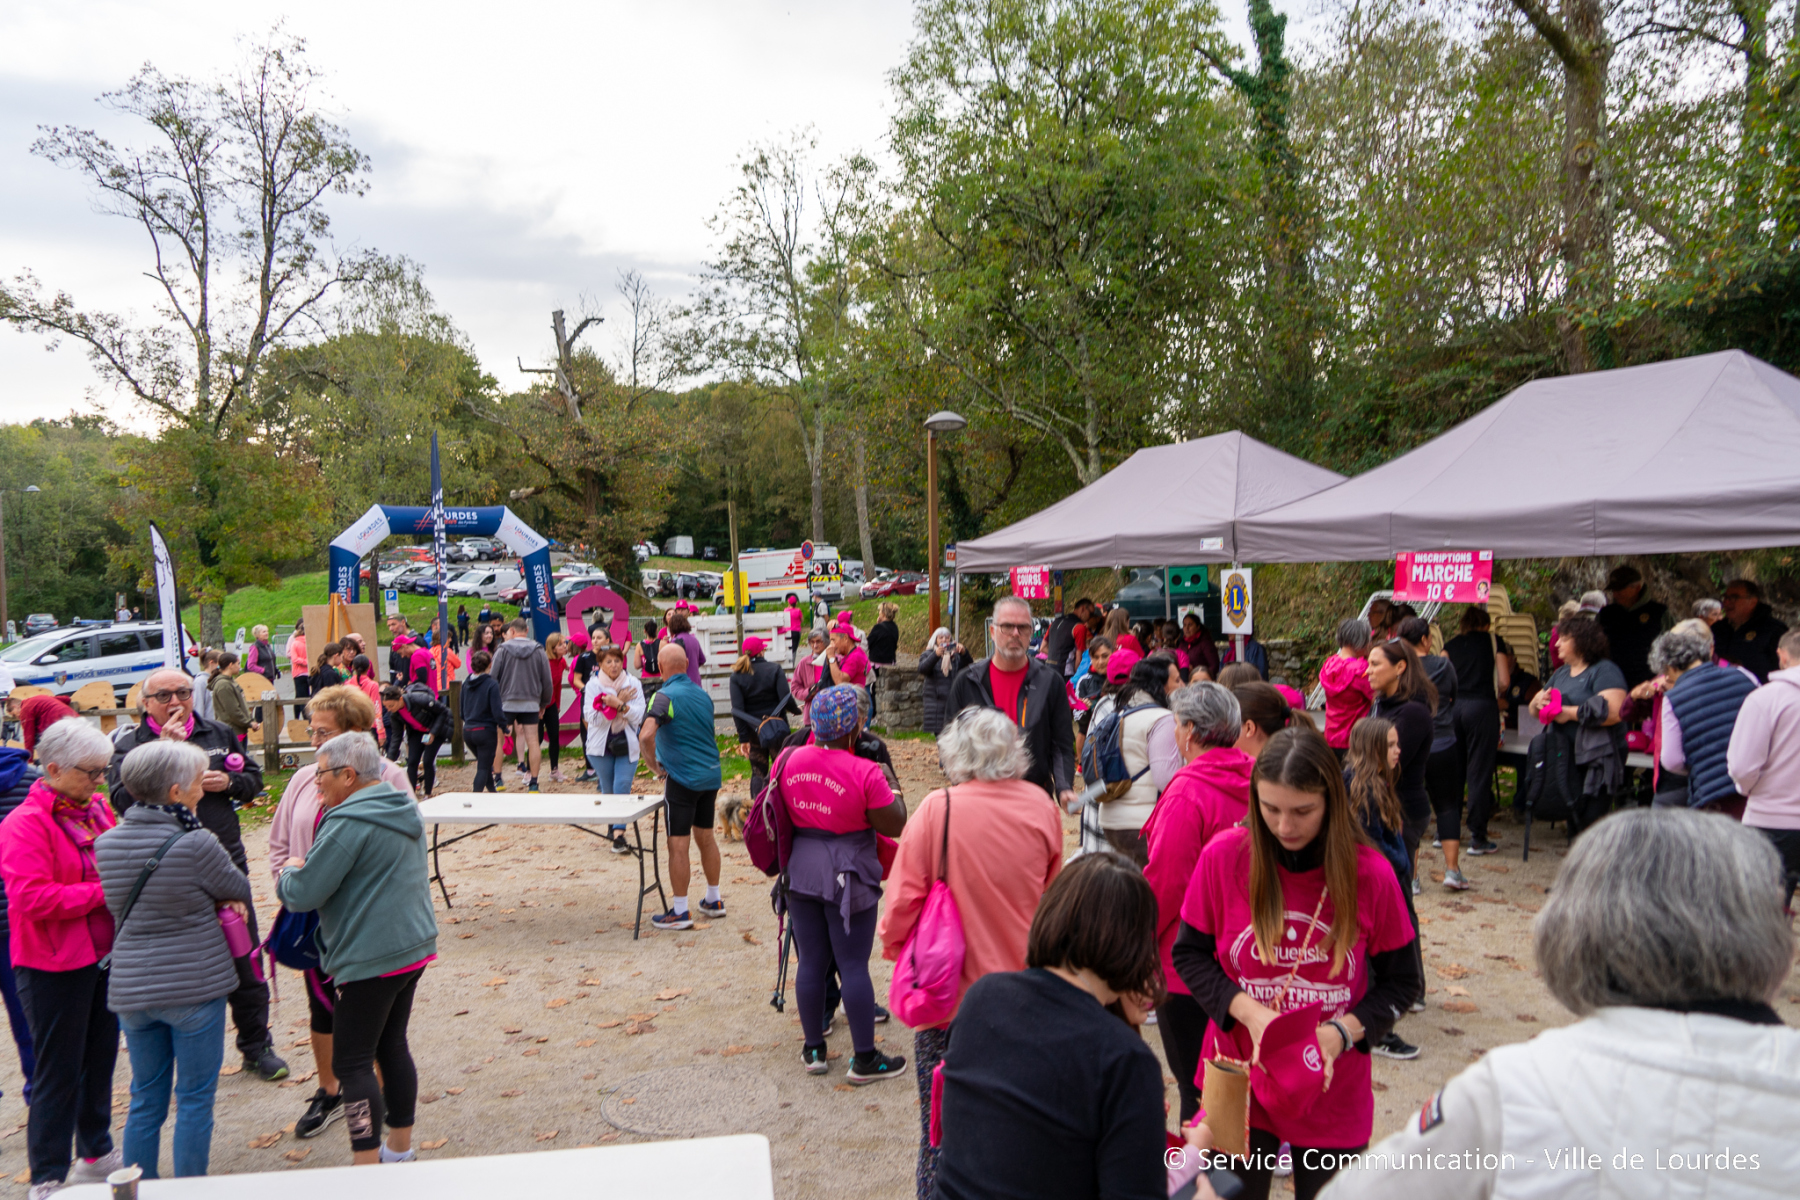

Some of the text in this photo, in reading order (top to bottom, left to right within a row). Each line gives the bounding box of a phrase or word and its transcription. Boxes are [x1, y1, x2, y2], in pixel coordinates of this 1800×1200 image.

[1414, 552, 1472, 563] INSCRIPTIONS
[1017, 574, 1042, 586] COURSE
[1411, 564, 1474, 582] MARCHE
[533, 564, 547, 608] LOURDES
[1023, 586, 1036, 597] 10 €
[1426, 584, 1455, 600] 10 €
[1232, 588, 1241, 610] L
[74, 670, 94, 679] POLICE
[97, 667, 131, 677] MUNICIPALE
[286, 755, 293, 764] 3
[786, 772, 846, 797] OCTOBRE ROSE
[793, 797, 832, 815] Lourdes
[1287, 987, 1351, 1003] THERMES
